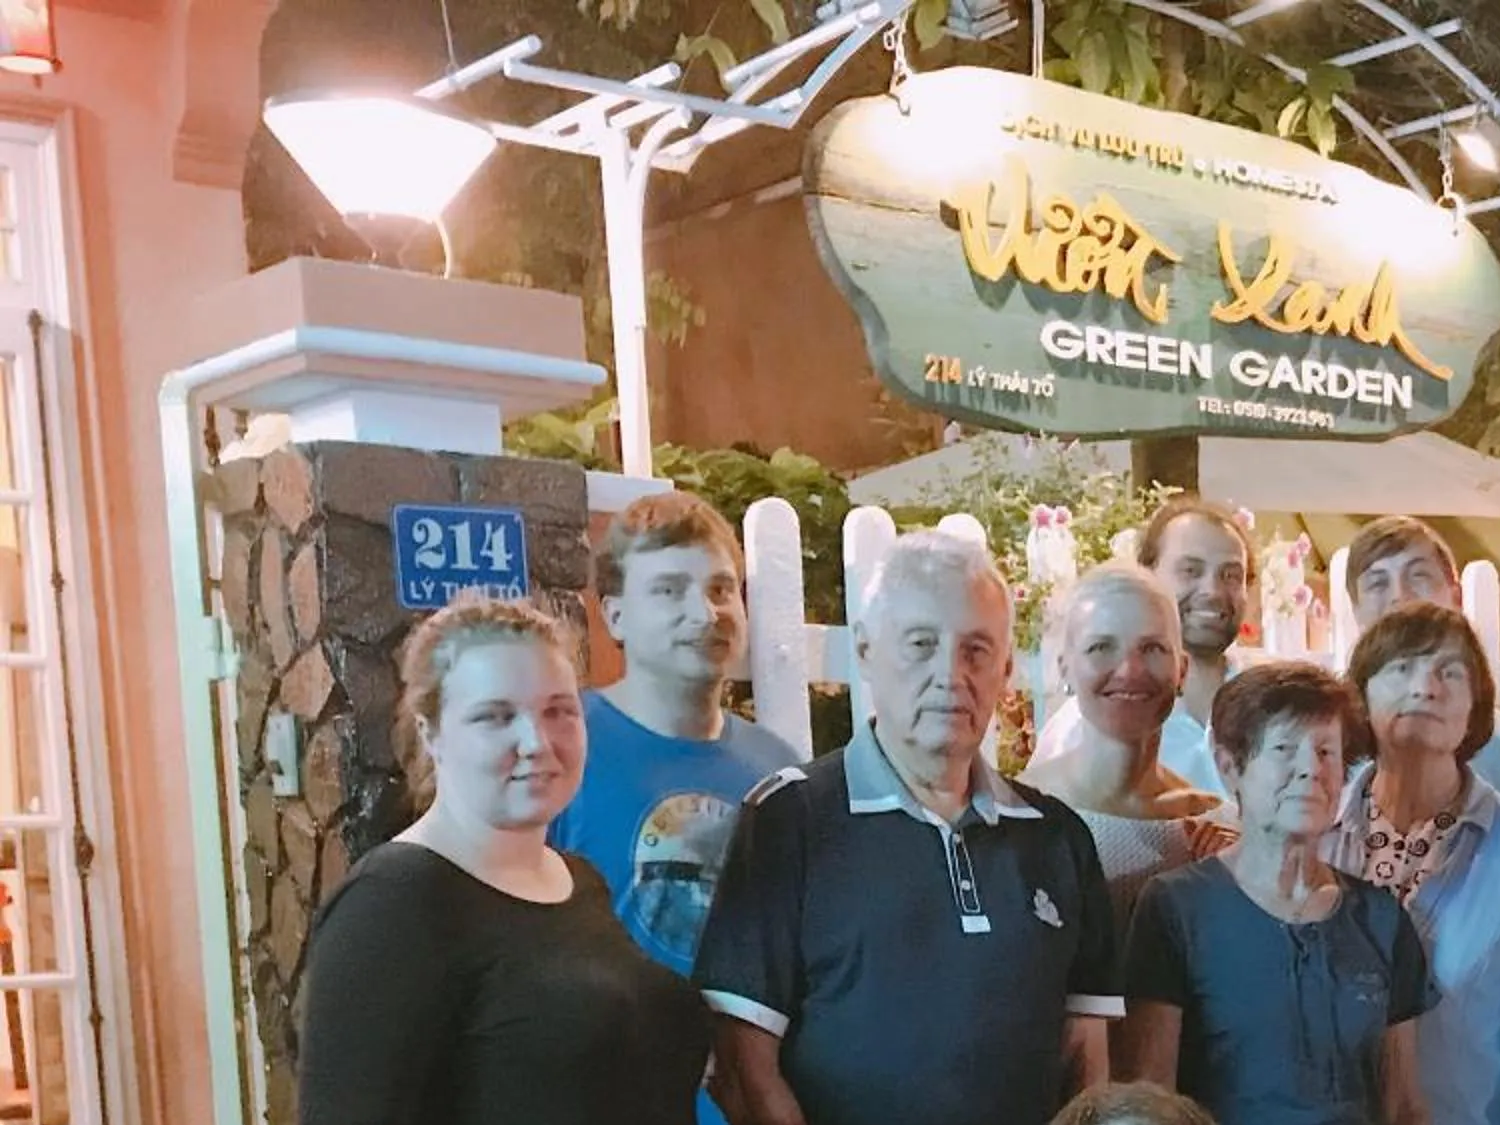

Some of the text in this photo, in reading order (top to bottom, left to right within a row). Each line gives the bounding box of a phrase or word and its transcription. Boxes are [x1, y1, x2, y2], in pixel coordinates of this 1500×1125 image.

[1211, 157, 1341, 206] HOMESTA
[924, 352, 963, 385] 214
[1039, 319, 1414, 409] GREEN GARDEN
[411, 517, 513, 572] 214
